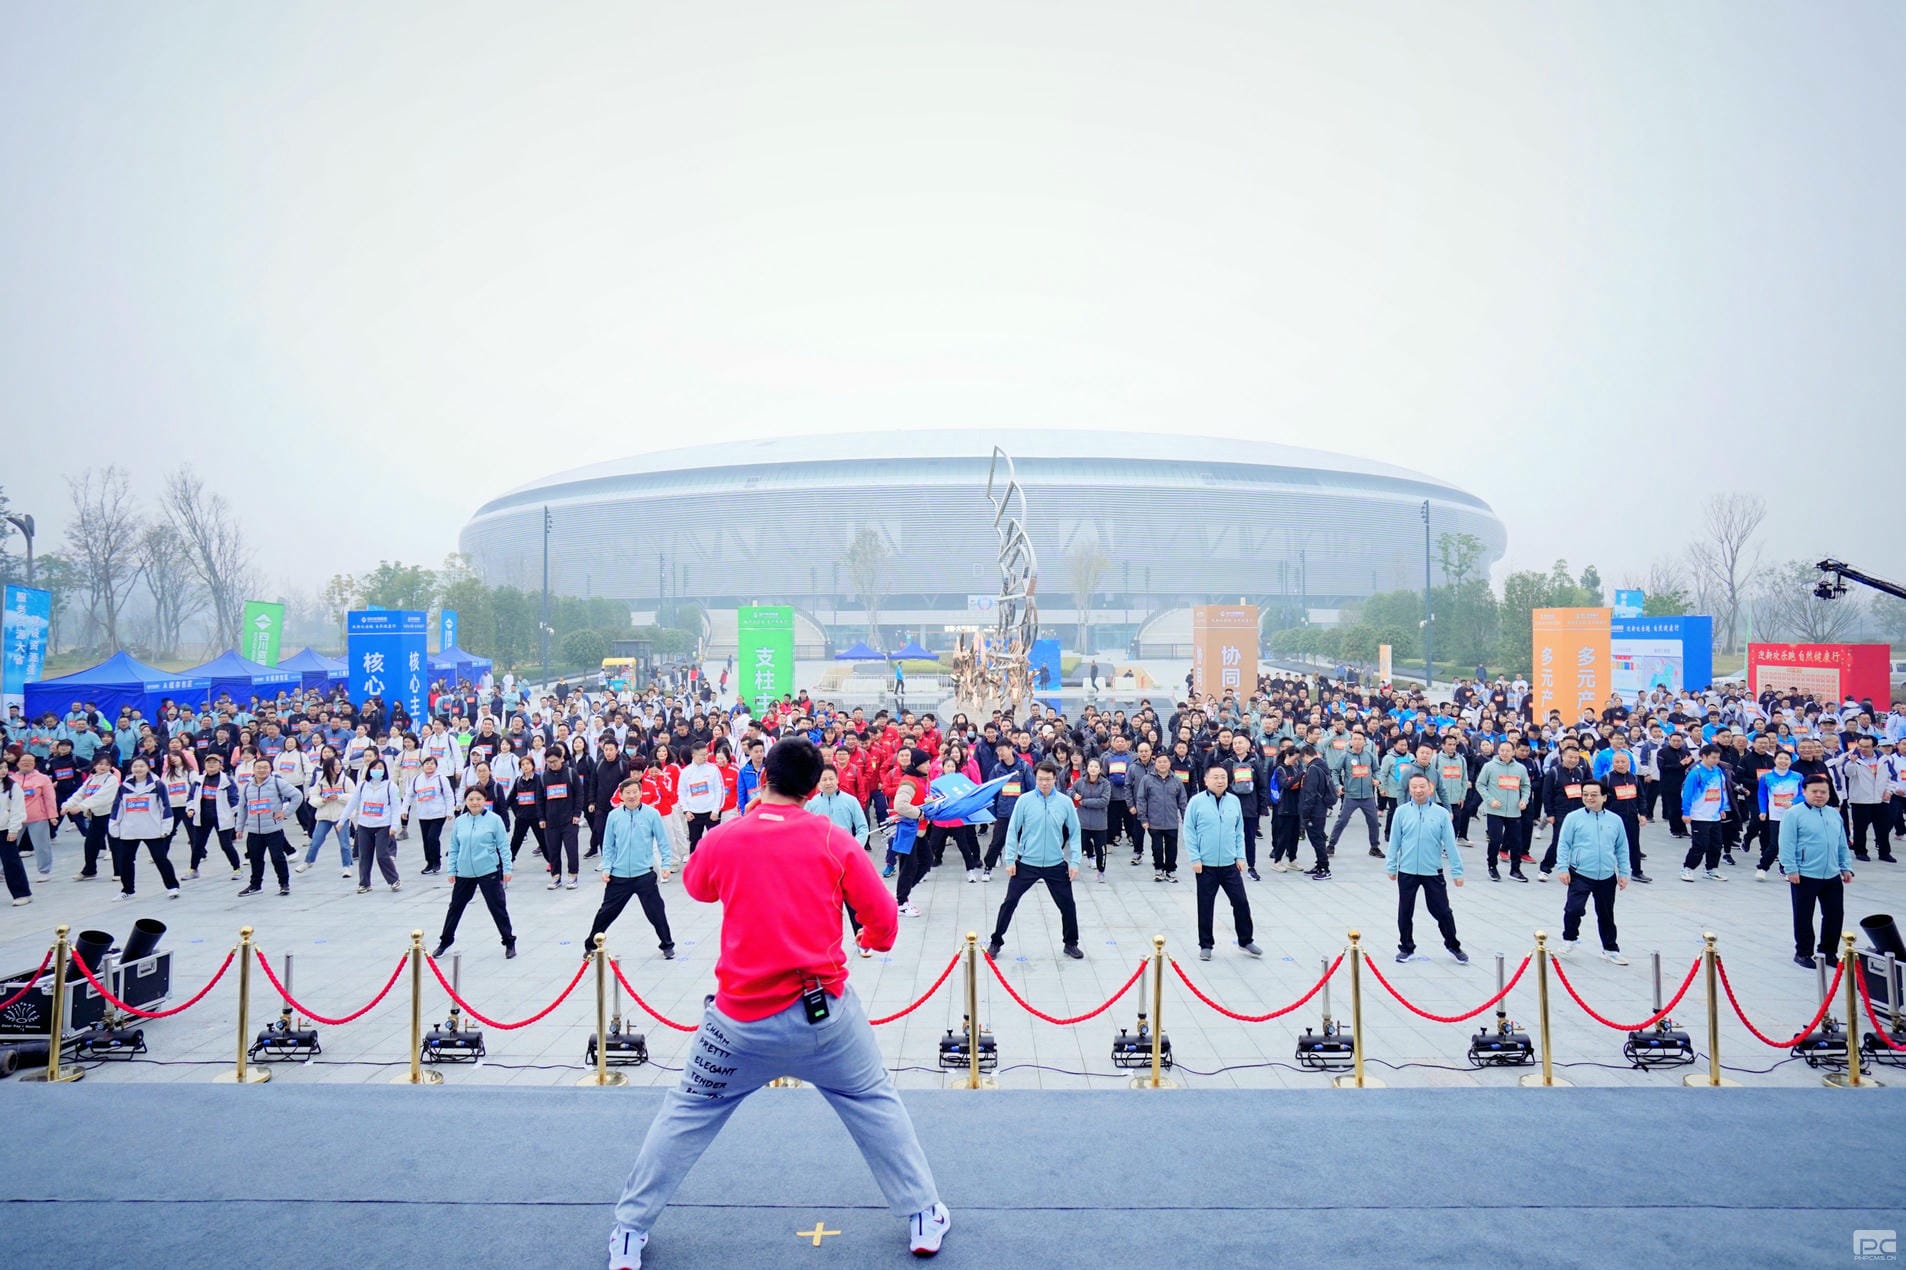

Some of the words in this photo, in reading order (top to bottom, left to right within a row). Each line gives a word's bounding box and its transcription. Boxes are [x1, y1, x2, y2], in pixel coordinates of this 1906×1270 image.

[363, 651, 385, 696] 核心
[1577, 646, 1597, 727] 多元产
[705, 1022, 730, 1047] CHARM
[699, 1036, 732, 1059] PRETTY
[694, 1055, 738, 1076] ELEGANT
[691, 1071, 728, 1089] TENDER
